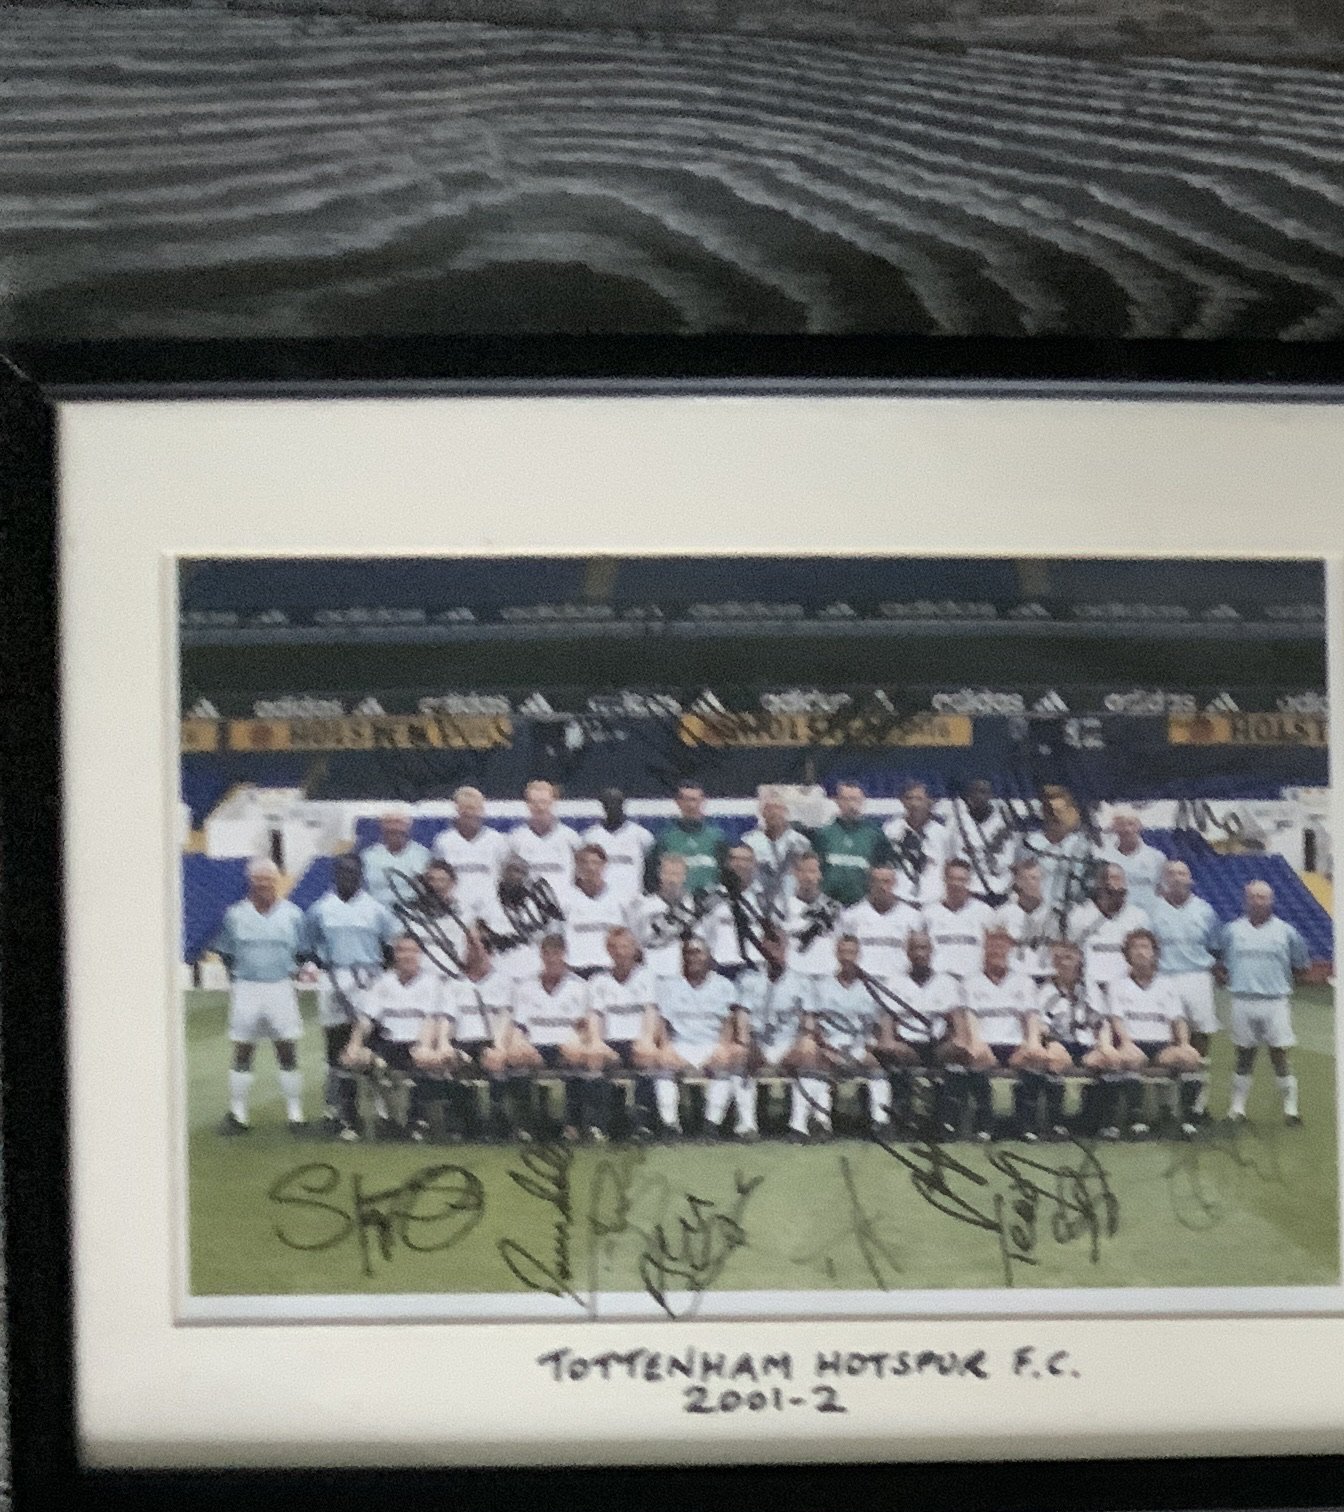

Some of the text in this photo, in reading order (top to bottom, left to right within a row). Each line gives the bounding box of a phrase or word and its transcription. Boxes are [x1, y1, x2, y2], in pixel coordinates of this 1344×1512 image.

[537, 1346, 1083, 1383] TOTTENHAM HOTSPUR F.C.
[682, 1384, 849, 1415] 2001-2
